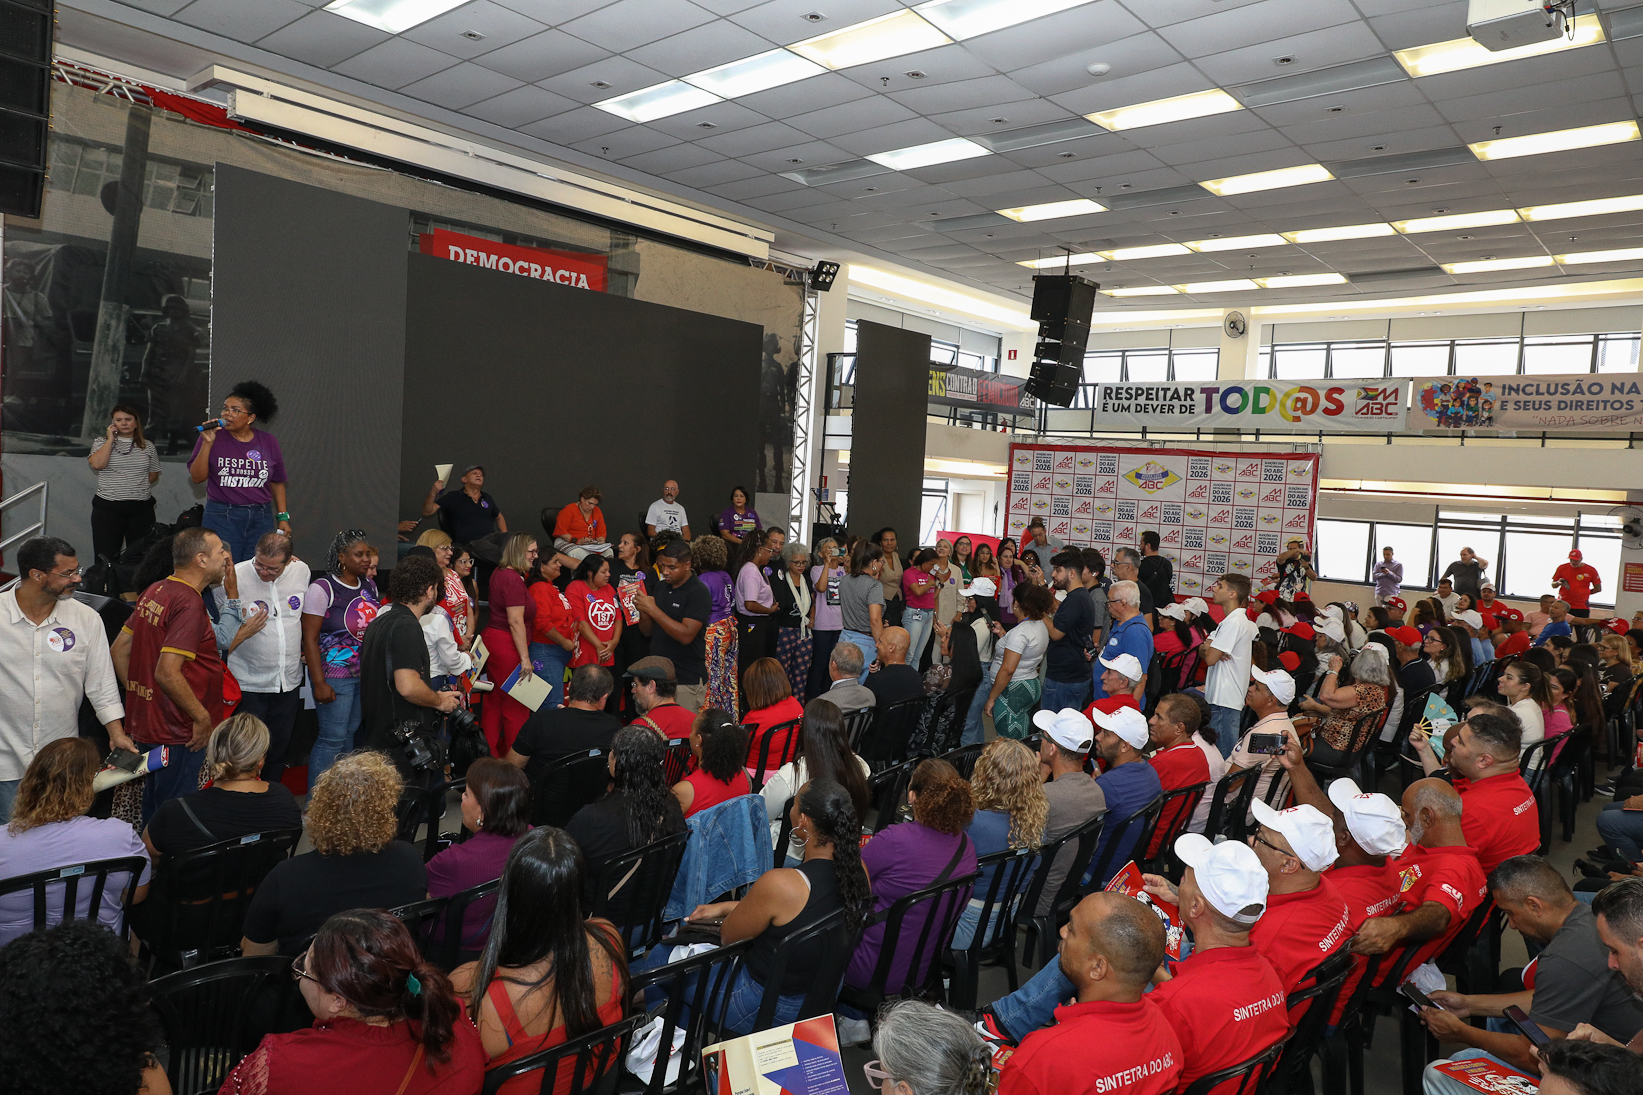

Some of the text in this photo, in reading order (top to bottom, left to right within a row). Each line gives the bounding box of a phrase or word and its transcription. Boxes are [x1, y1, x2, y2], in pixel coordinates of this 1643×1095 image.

[449, 245, 590, 290] DEMOCRACIA
[946, 373, 973, 394] CONTRA
[1502, 379, 1641, 396] INCLUSÃO NA
[1102, 400, 1195, 414] É UM DEVER DE
[1104, 386, 1346, 422] RESPEITAR TOD@S
[1354, 402, 1398, 415] ABC
[1500, 400, 1634, 411] E SEUS DIREITOS
[1580, 415, 1628, 425] SOBRE
[218, 457, 268, 470] RESPEITE
[1139, 481, 1163, 489] ABC
[1366, 896, 1392, 916] SINTETRA
[1318, 919, 1345, 952] SINTETRA
[1233, 999, 1272, 1021] SINTETRA
[1096, 1052, 1174, 1093] SINTETRA DO ABC
